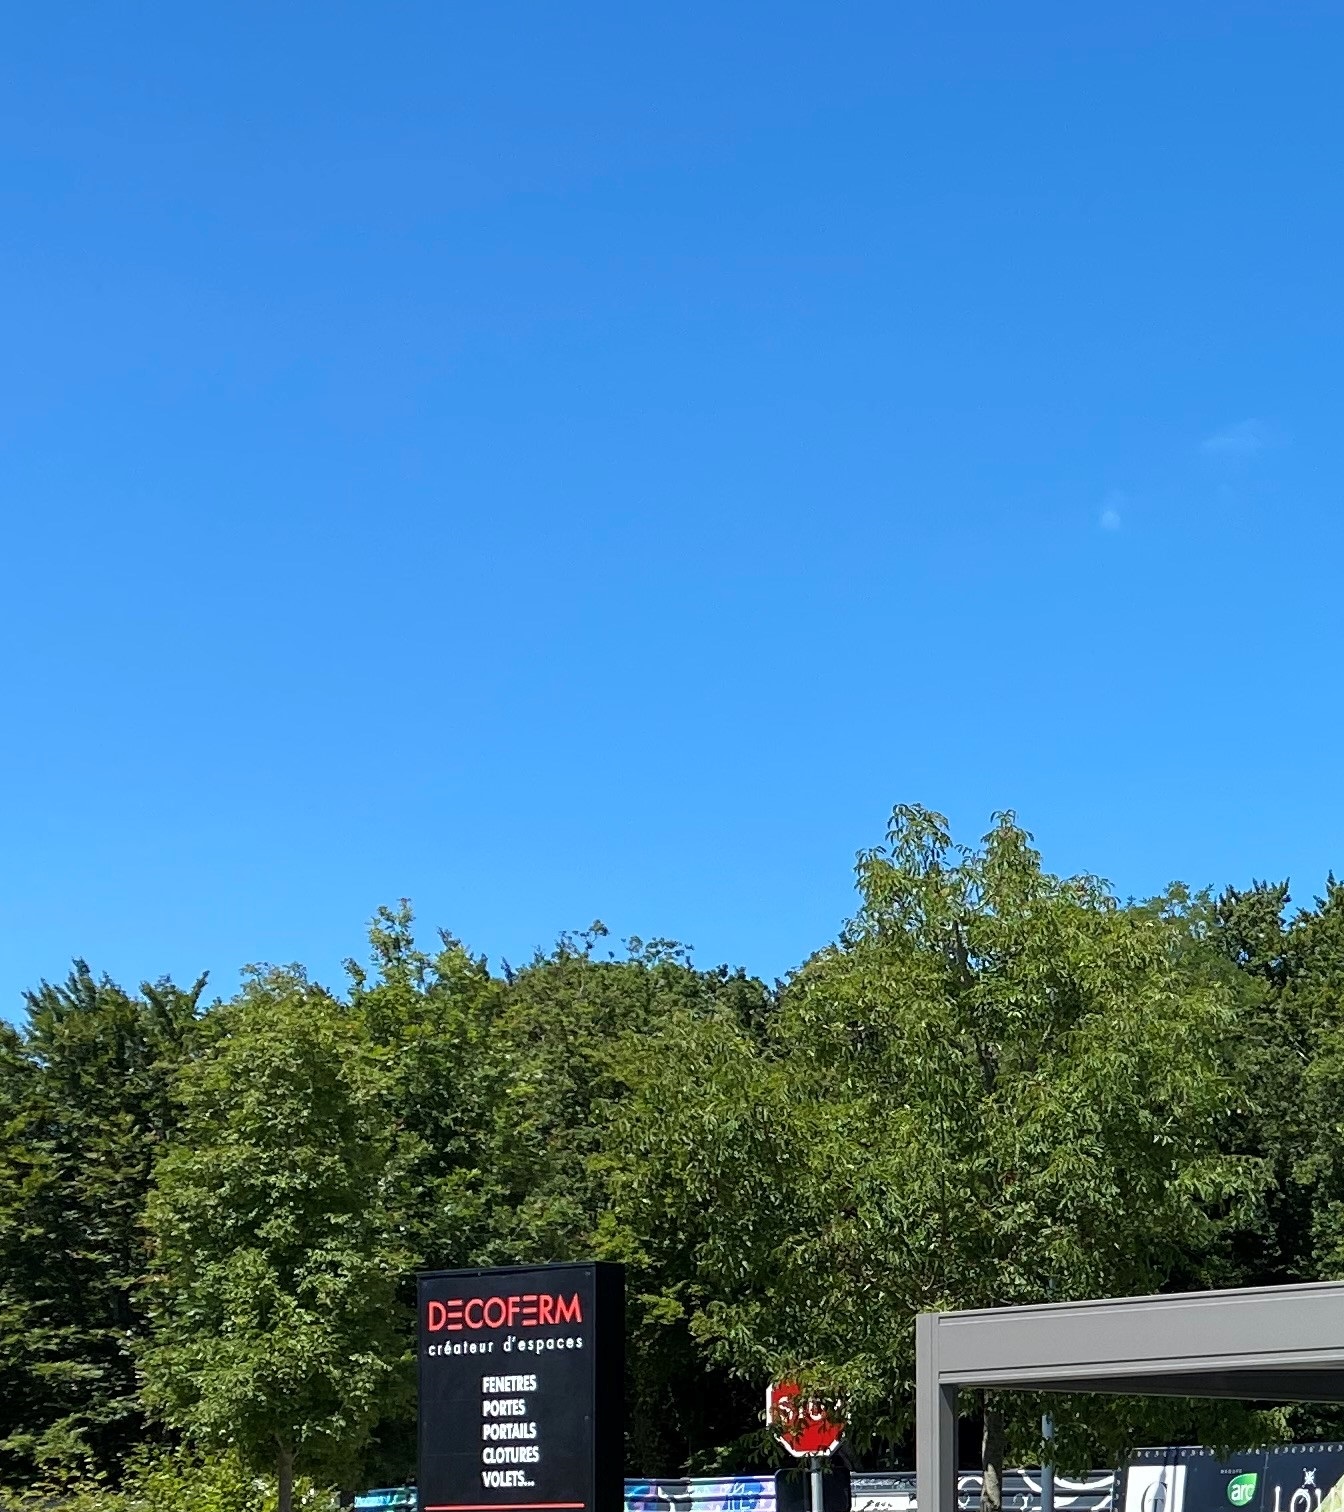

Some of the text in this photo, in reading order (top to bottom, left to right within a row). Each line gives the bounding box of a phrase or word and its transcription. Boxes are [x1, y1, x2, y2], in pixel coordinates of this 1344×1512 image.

[428, 1293, 582, 1331] DECOFERM
[428, 1335, 583, 1356] créateur d'espaces
[482, 1374, 537, 1393] FENETRES
[482, 1399, 526, 1417] PORTES
[482, 1422, 537, 1440] PORTAILS
[482, 1446, 540, 1464] CLOTURES
[482, 1470, 535, 1488] VOLETS...
[1231, 1484, 1256, 1501] arc
